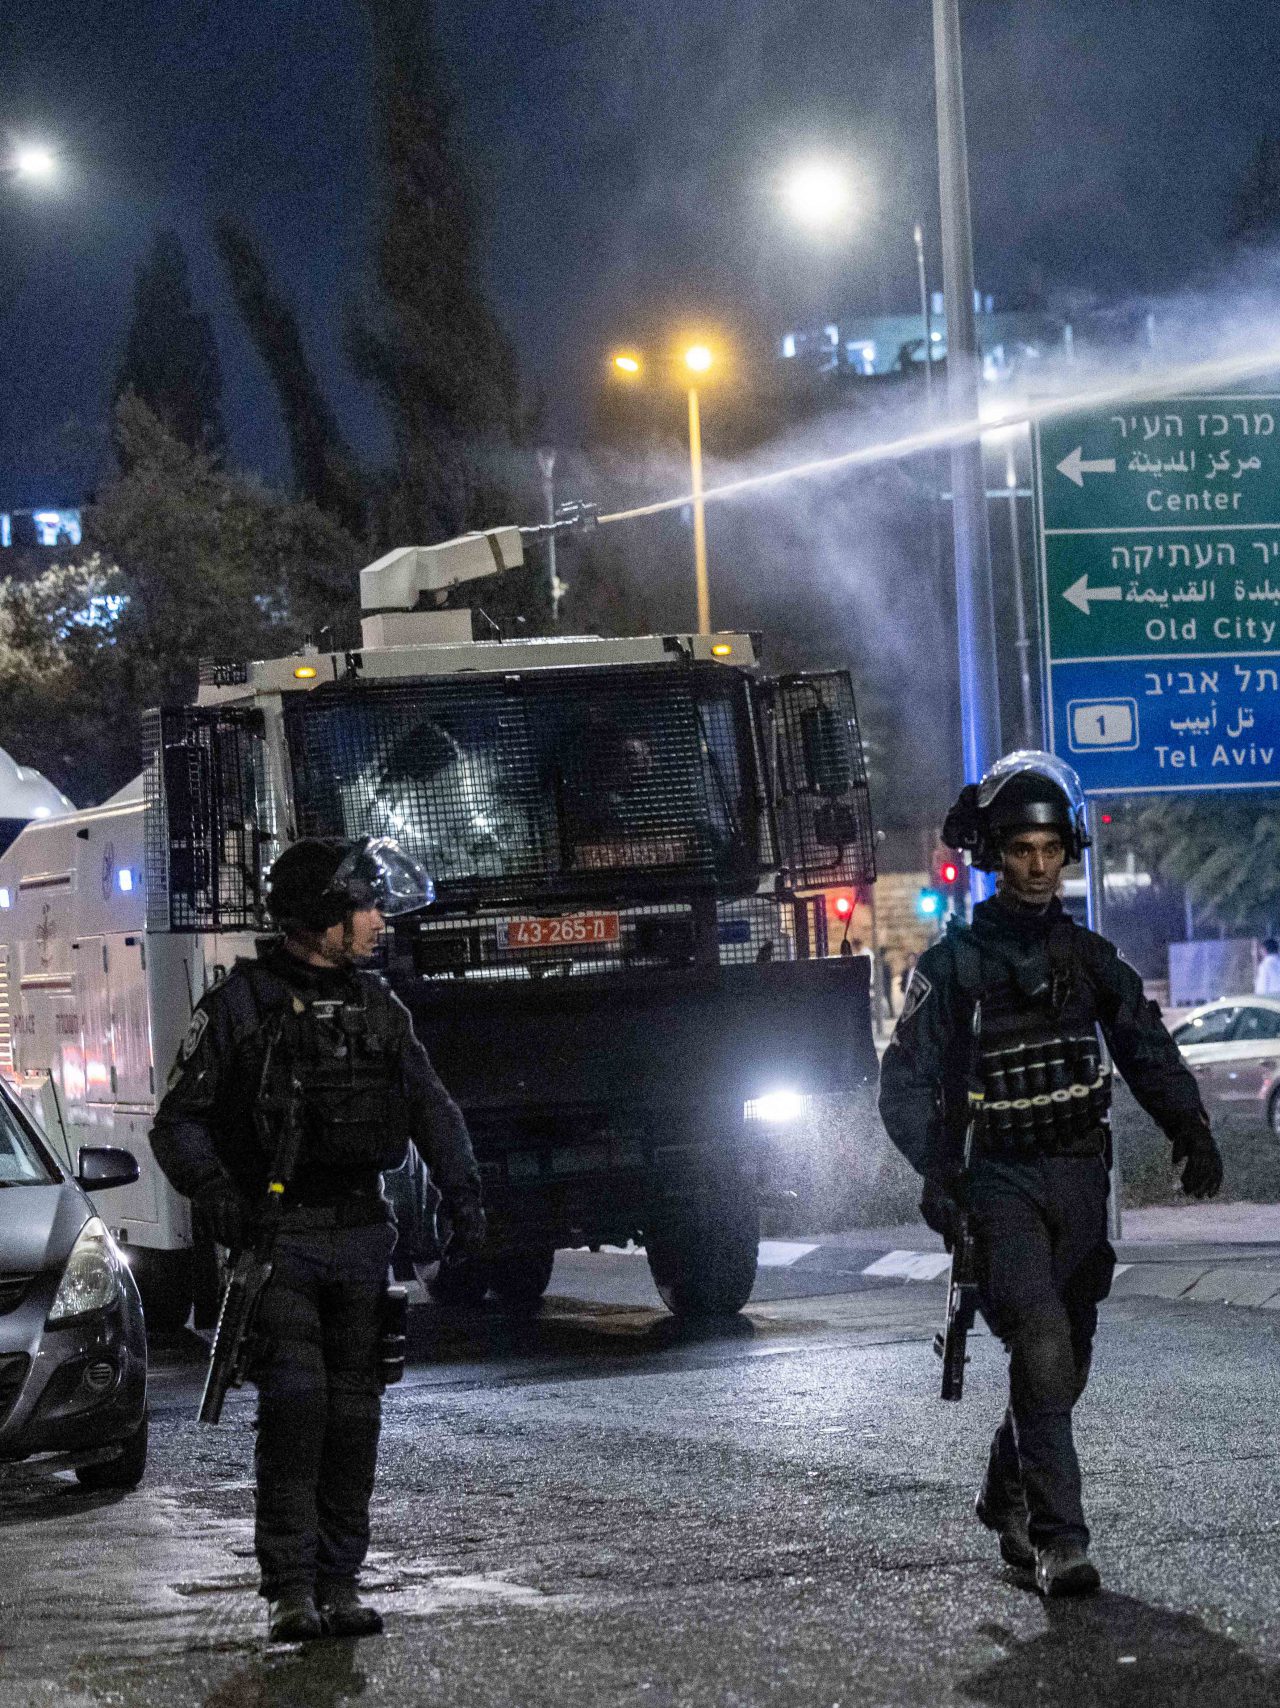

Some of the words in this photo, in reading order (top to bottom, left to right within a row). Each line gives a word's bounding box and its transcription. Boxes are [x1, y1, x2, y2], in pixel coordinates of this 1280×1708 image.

[1110, 414, 1183, 440] העיר
[1199, 412, 1275, 436] מרכז
[1128, 450, 1195, 477] المدينة
[1206, 449, 1262, 479] مركز
[1146, 489, 1242, 512] Center
[1111, 543, 1236, 575] העתיקה
[1126, 580, 1215, 607] القديمة
[1145, 618, 1197, 641] Old
[1213, 616, 1276, 643] City
[1144, 671, 1219, 696] אביב
[1234, 664, 1278, 692] תל
[1096, 715, 1106, 736] 1
[1170, 700, 1217, 735] أبيب
[1226, 708, 1254, 737] تل
[1154, 746, 1198, 768] Tel
[1211, 743, 1274, 767] Aviv
